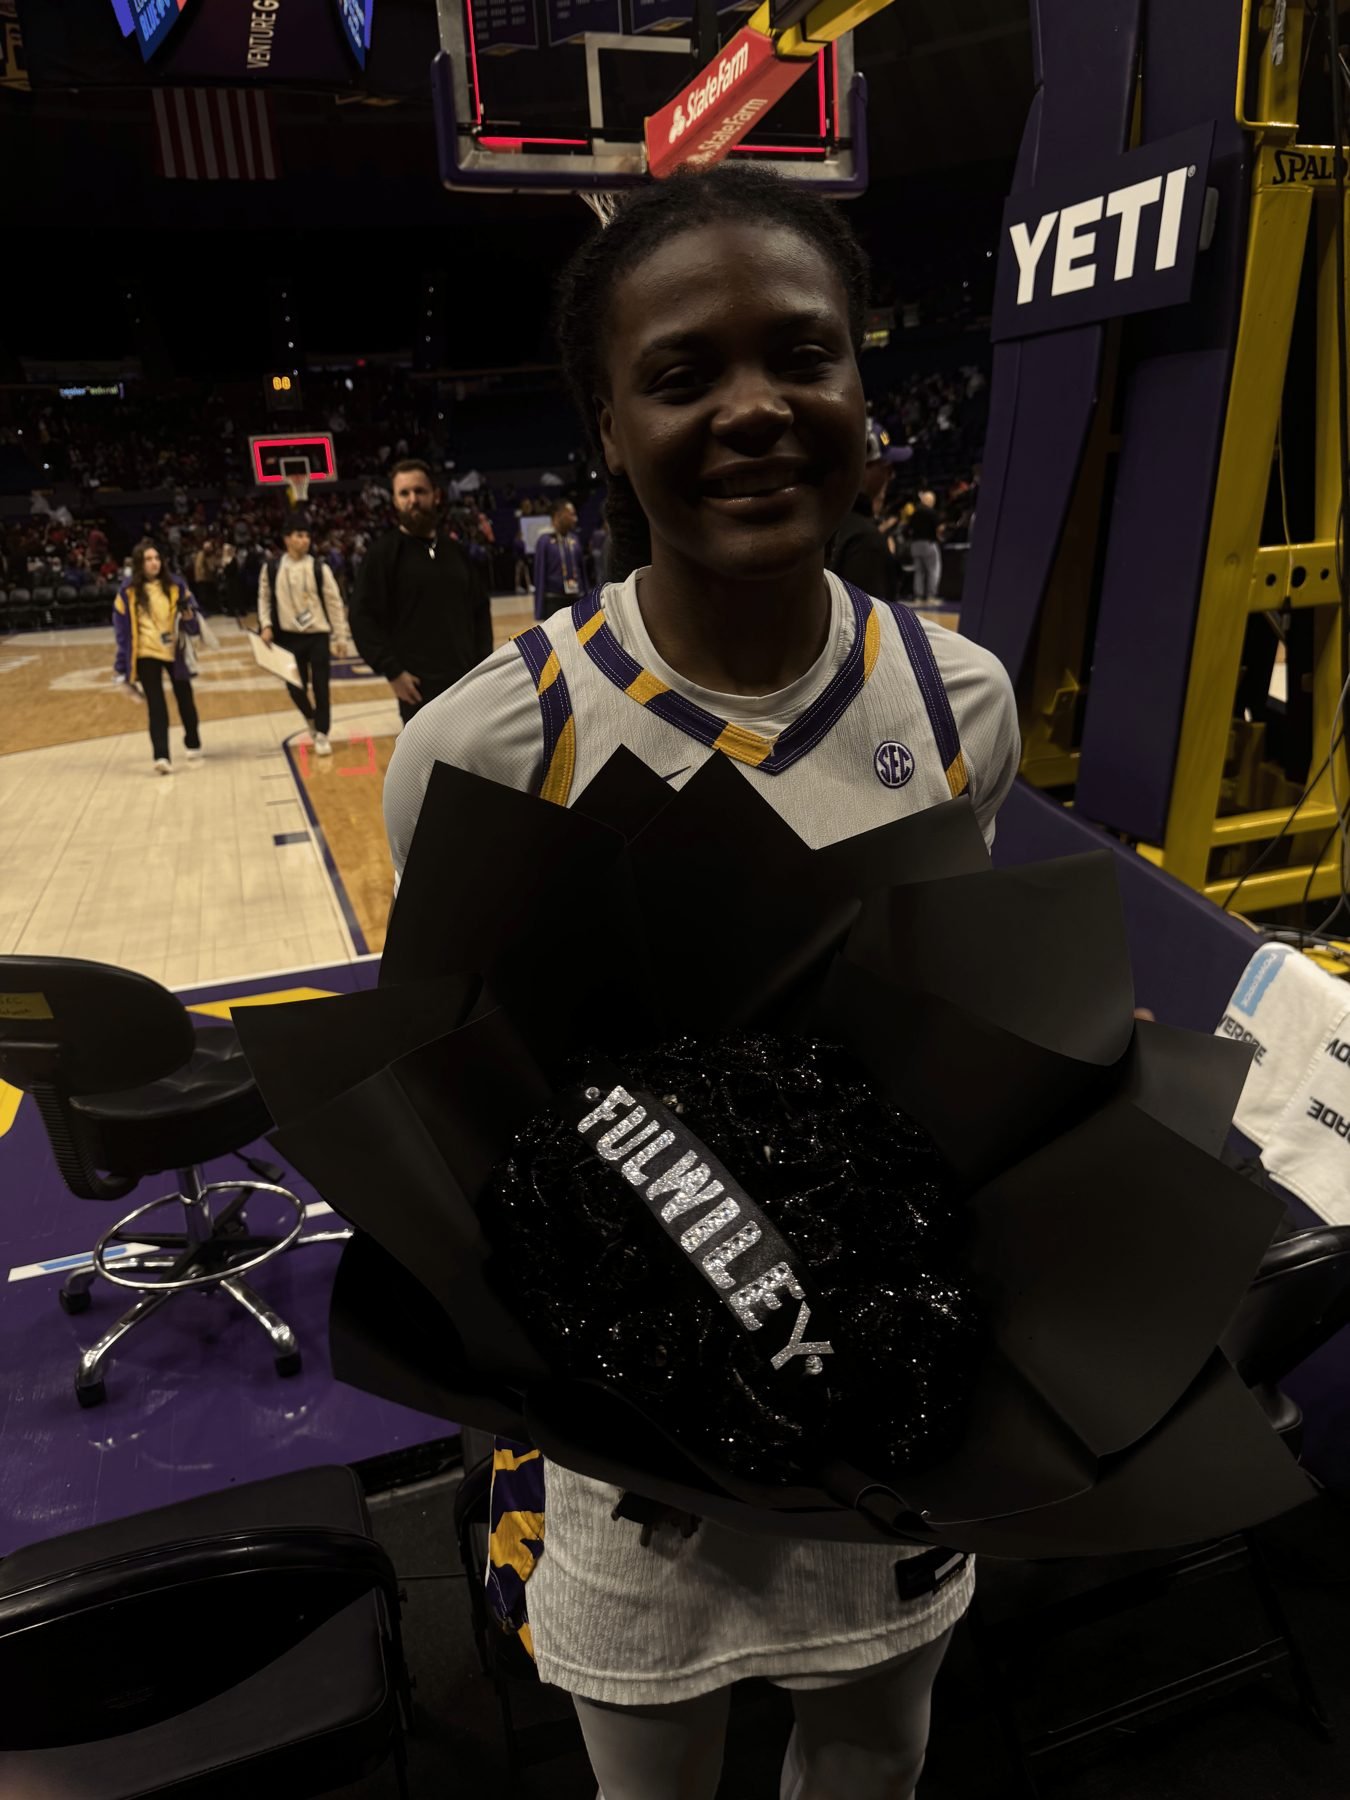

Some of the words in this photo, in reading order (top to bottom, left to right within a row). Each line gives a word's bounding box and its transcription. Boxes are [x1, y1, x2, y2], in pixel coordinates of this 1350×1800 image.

[246, 11, 277, 69] VENTURE
[1008, 166, 1188, 306] YETI
[877, 744, 911, 784] SEC
[1306, 1096, 1350, 1145] ADE.
[576, 1084, 836, 1371] FULWILEY
